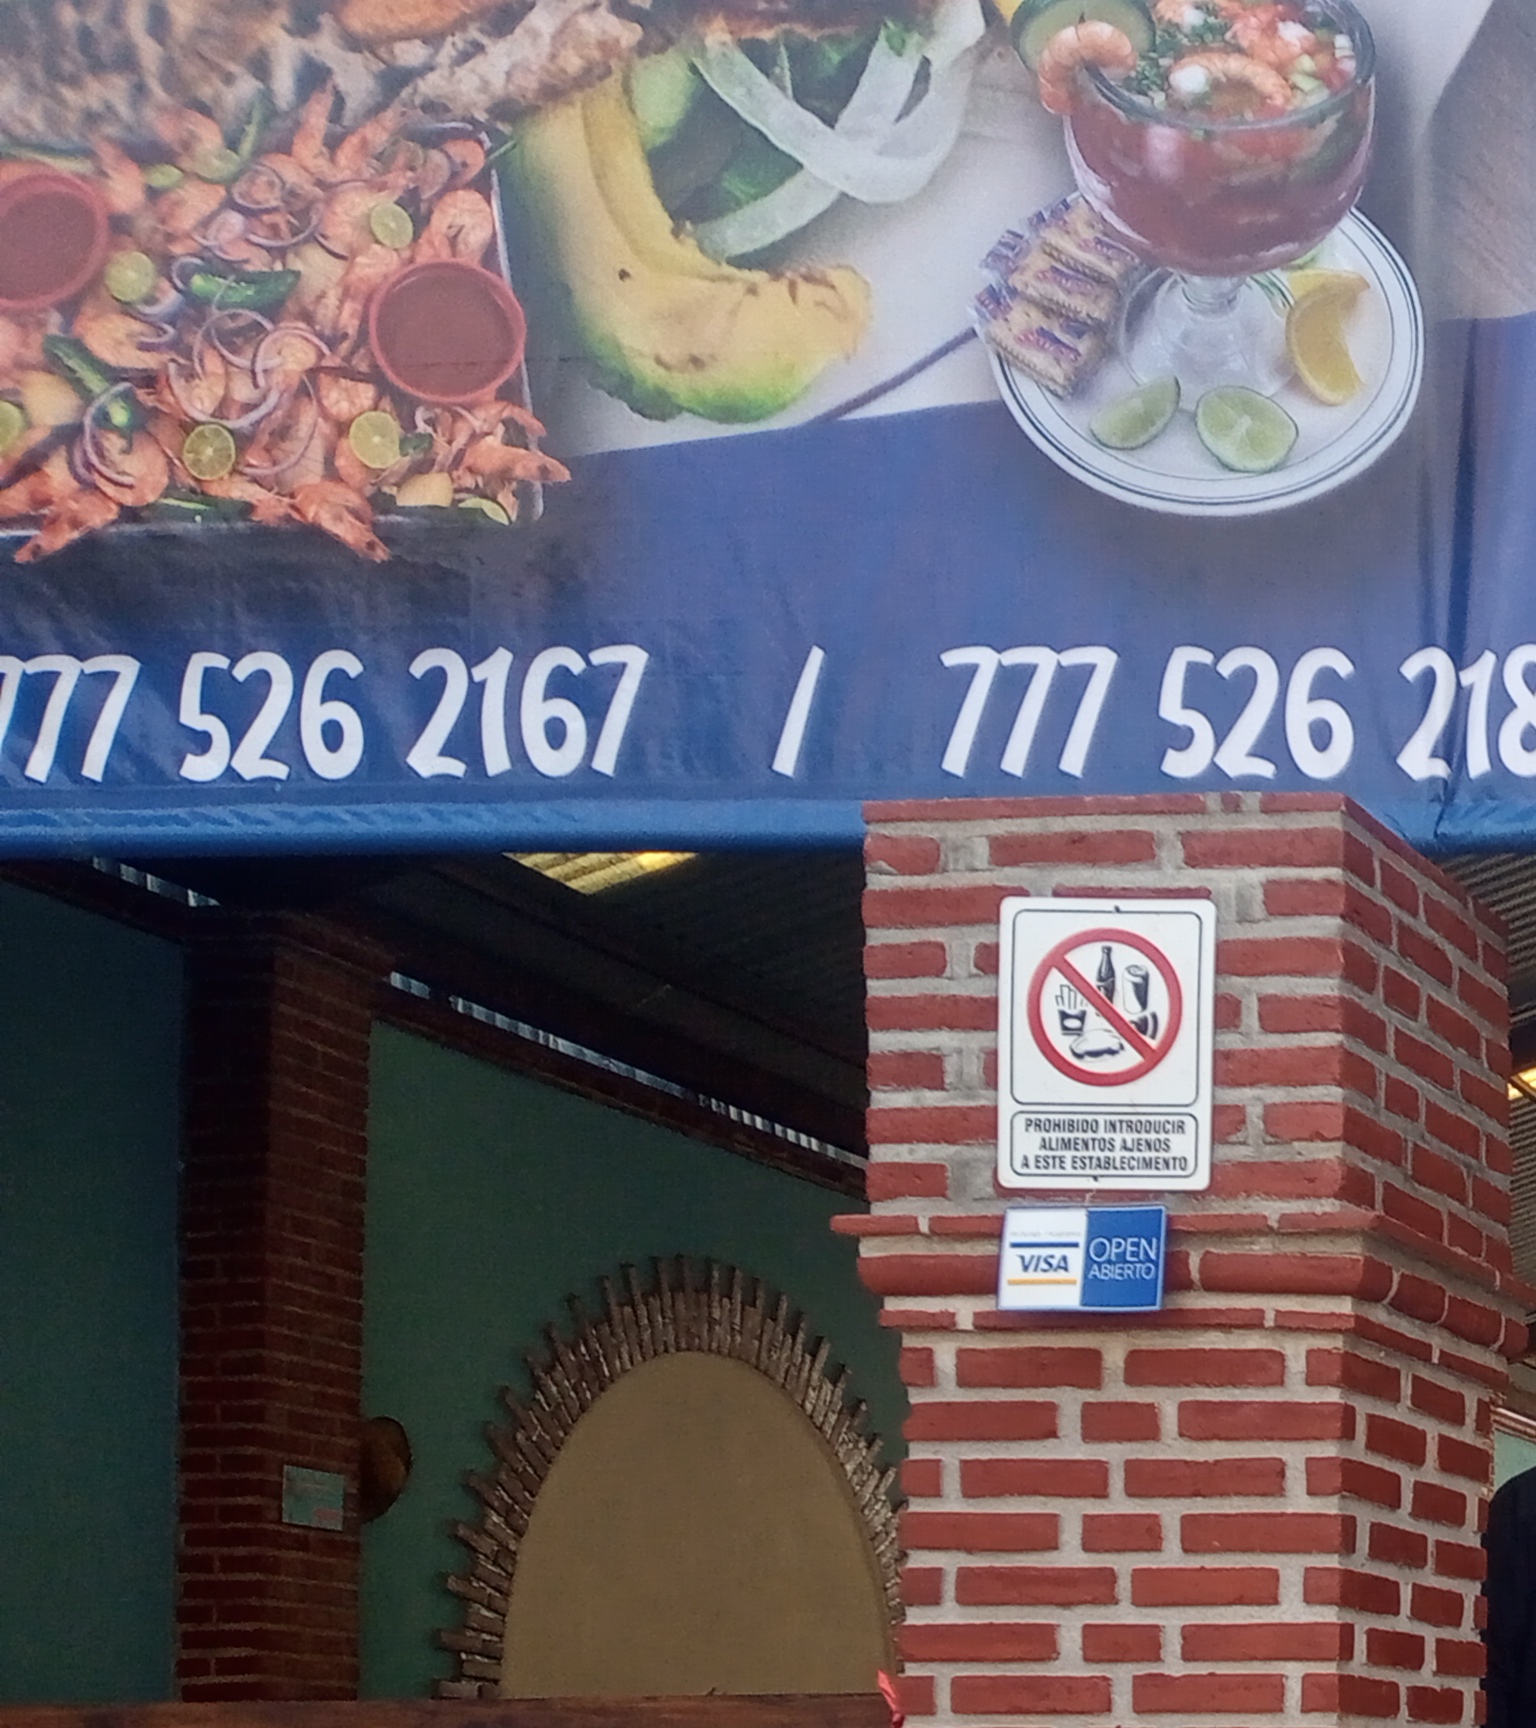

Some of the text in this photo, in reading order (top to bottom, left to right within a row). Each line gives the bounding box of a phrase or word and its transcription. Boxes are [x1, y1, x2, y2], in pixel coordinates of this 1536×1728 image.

[178, 649, 365, 782] 526
[405, 644, 650, 779] 2167
[938, 645, 1119, 780] 777
[1157, 646, 1356, 781] 526
[1024, 1117, 1186, 1135] PROHIBIDO INTRODUCIR
[1038, 1136, 1171, 1153] ALIMENTOS AJENOS
[1020, 1155, 1030, 1170] A
[1034, 1155, 1067, 1170] ESTE
[1088, 1237, 1157, 1262] OPEN
[1016, 1254, 1070, 1273] VISA
[1087, 1263, 1156, 1281] ABIERTO
